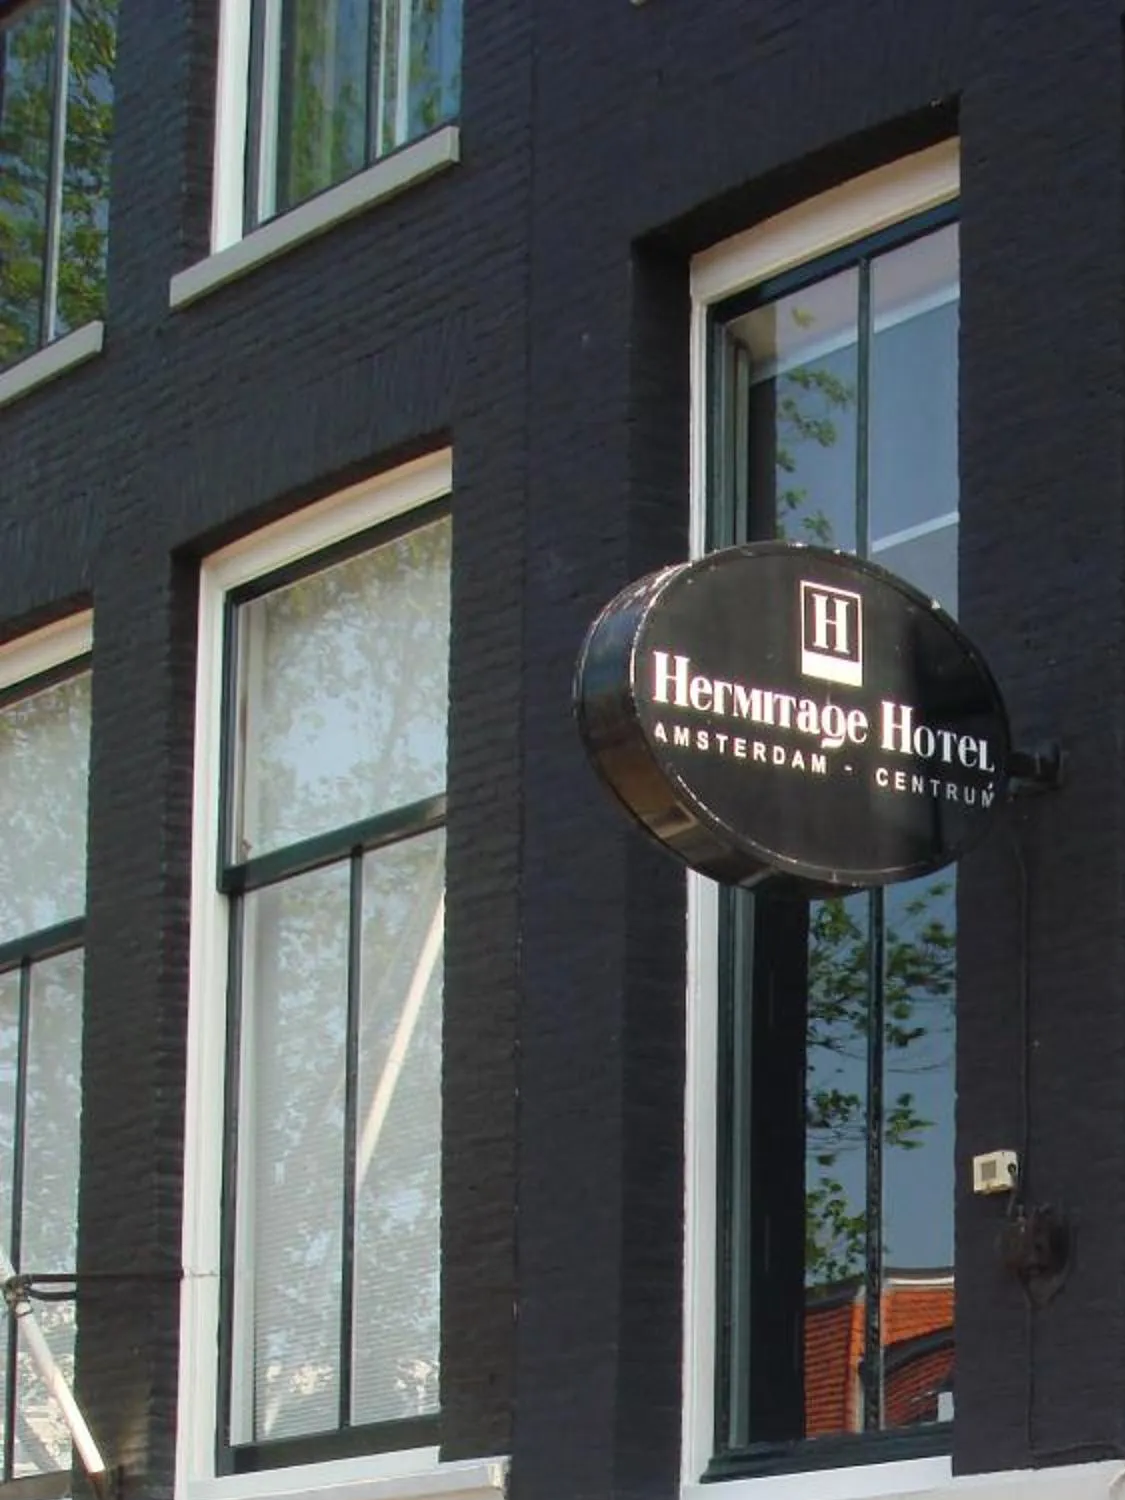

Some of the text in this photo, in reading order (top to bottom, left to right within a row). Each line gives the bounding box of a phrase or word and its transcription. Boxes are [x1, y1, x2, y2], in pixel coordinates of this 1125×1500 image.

[810, 592, 850, 655] H
[653, 721, 828, 775] AMSTERDAM
[875, 767, 996, 809] CENTRUM
